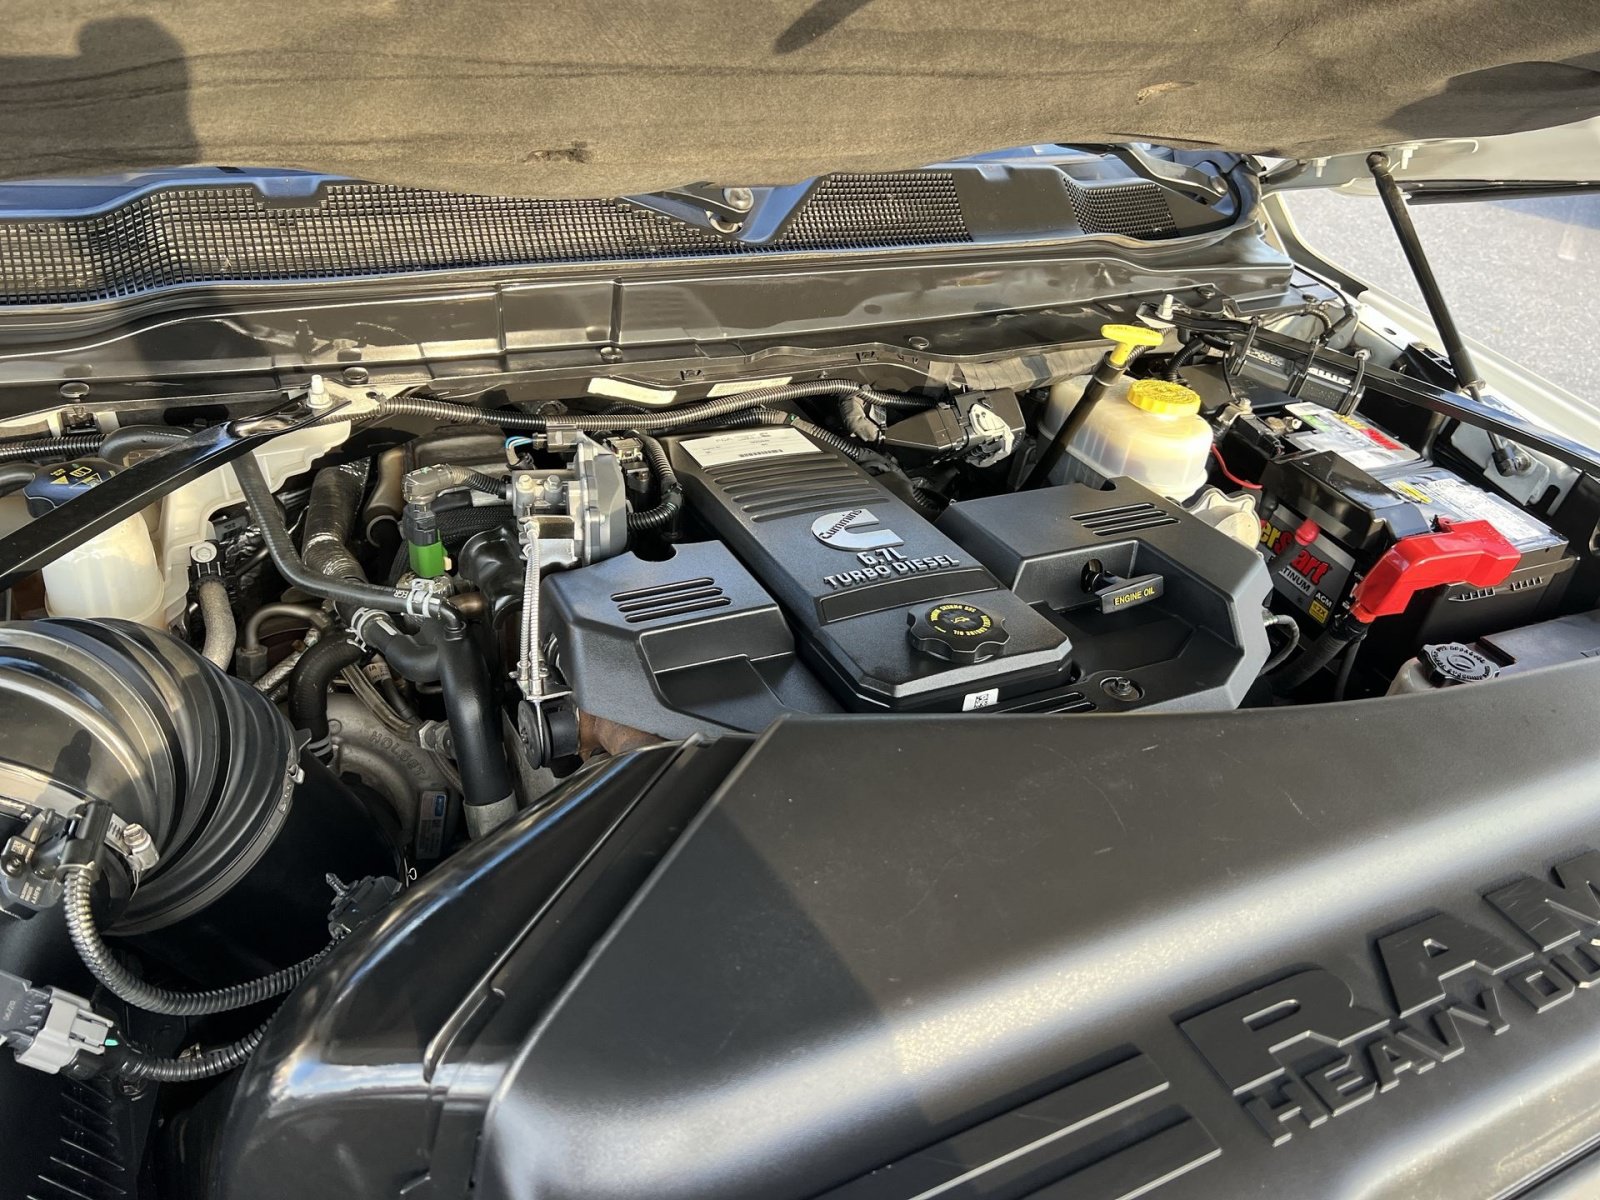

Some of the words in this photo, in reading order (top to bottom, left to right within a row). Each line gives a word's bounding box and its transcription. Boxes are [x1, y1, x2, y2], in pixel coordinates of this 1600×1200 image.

[819, 508, 863, 539] Cummins
[823, 564, 892, 589] TURBO
[891, 553, 960, 577] DIESEL
[857, 547, 908, 567] 6.7L
[393, 589, 409, 599] EGR
[1114, 590, 1142, 606] ENGINE
[1143, 586, 1156, 597] OIL
[1174, 849, 1600, 1096] RAM
[1243, 986, 1510, 1147] HEAVY
